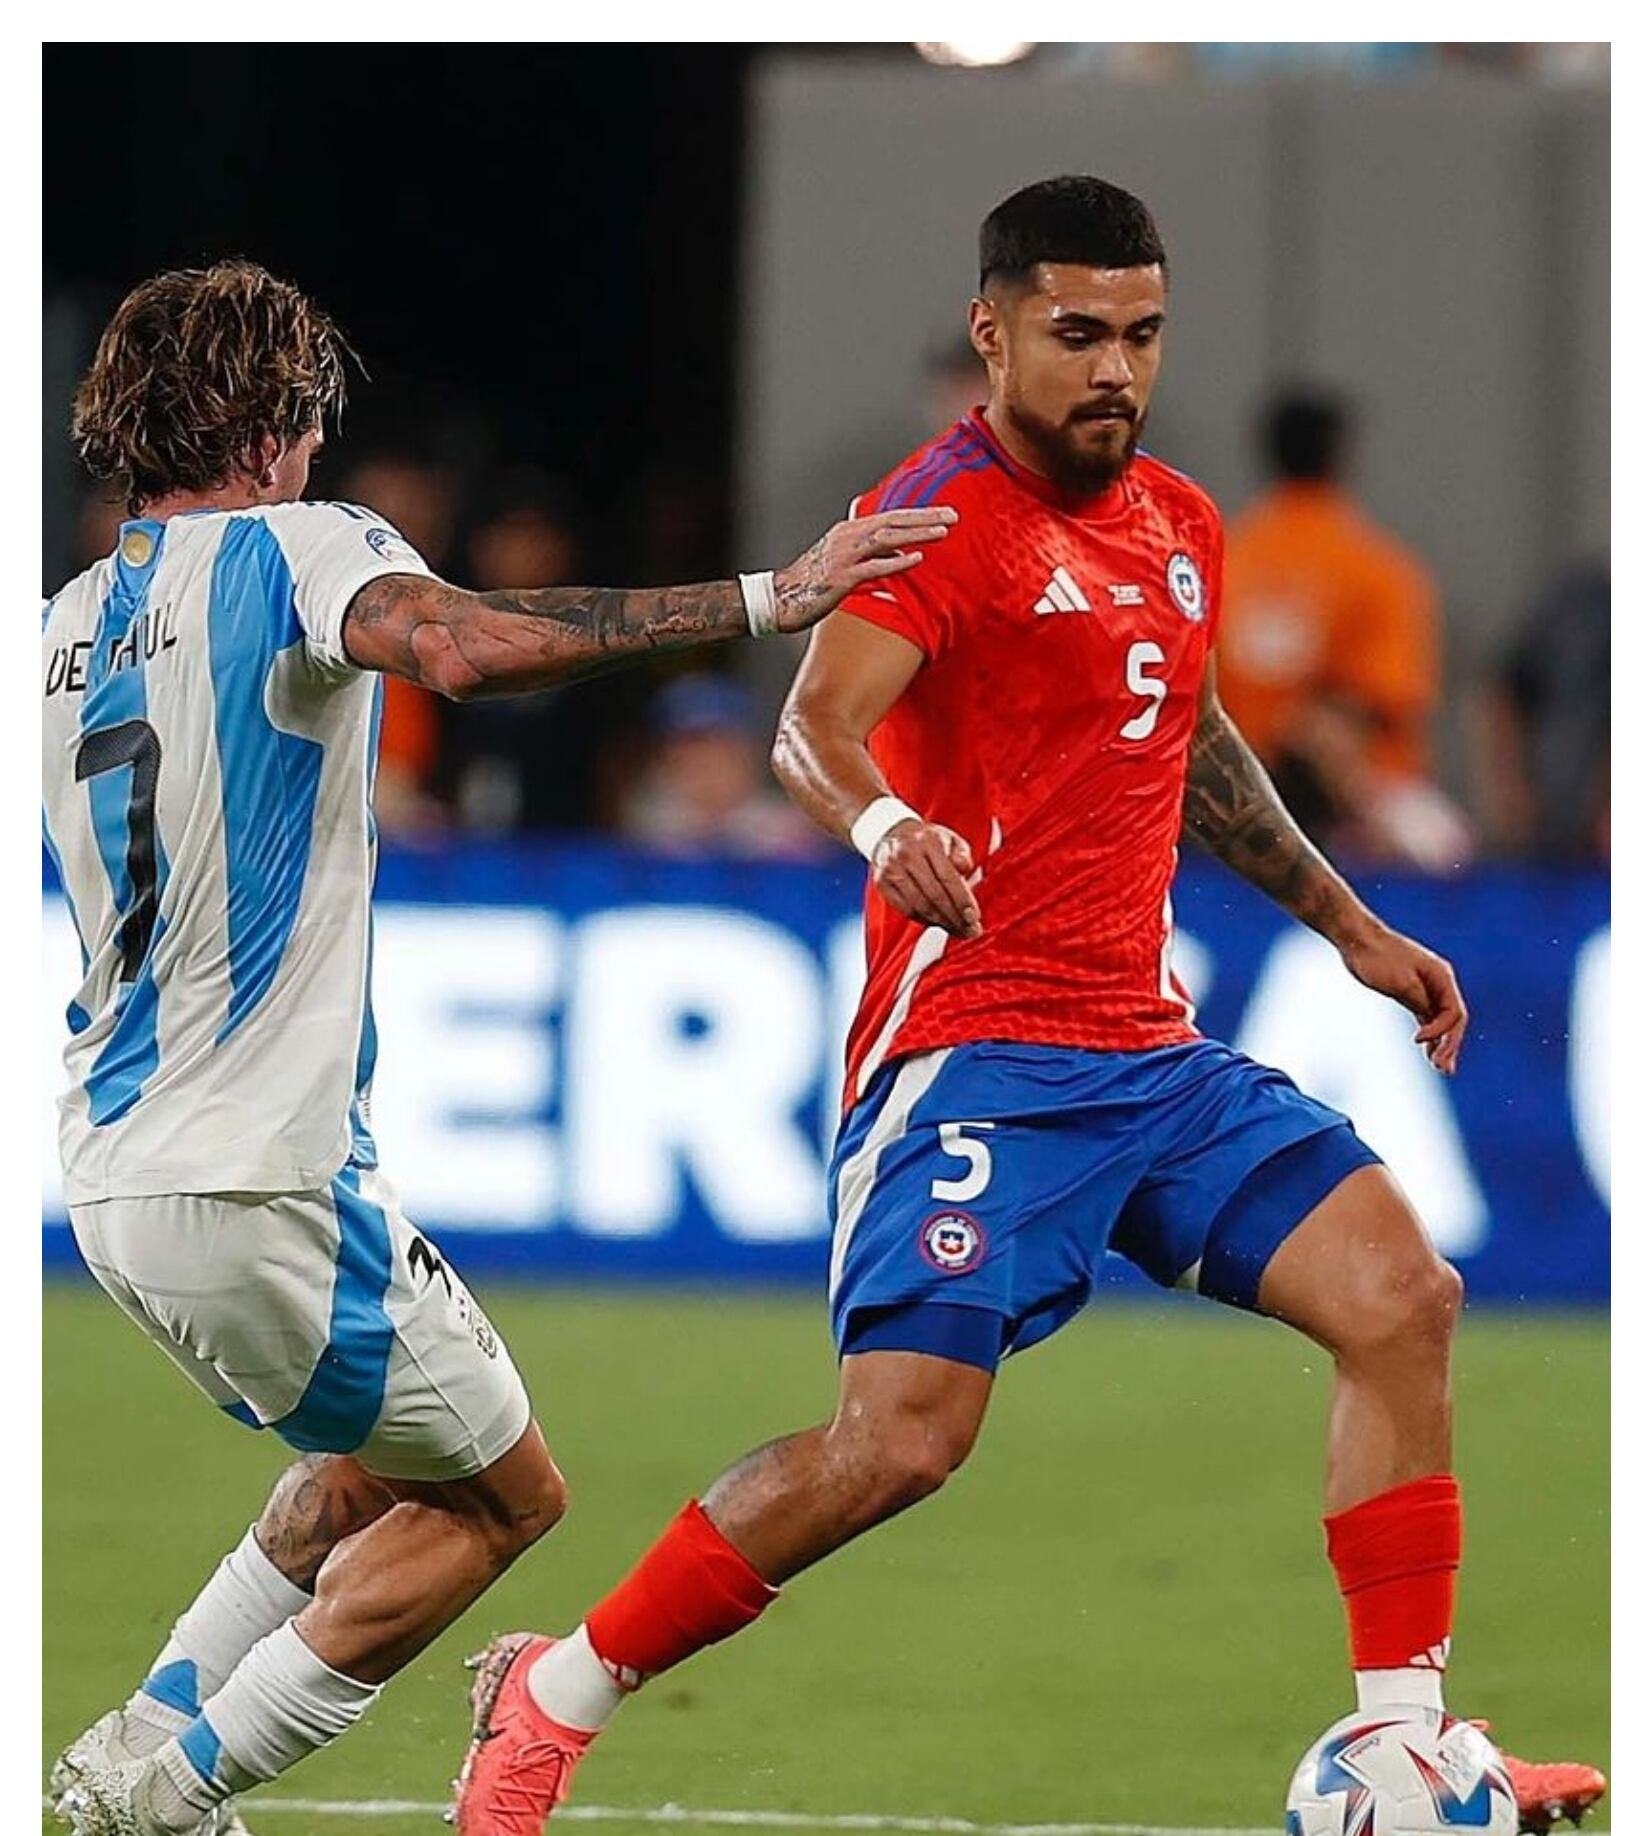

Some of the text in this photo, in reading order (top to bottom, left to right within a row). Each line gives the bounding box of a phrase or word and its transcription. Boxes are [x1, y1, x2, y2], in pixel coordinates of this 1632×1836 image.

[45, 640, 94, 697] DE
[1119, 640, 1168, 741] 5
[75, 720, 162, 983] 7
[930, 1121, 995, 1203] 5
